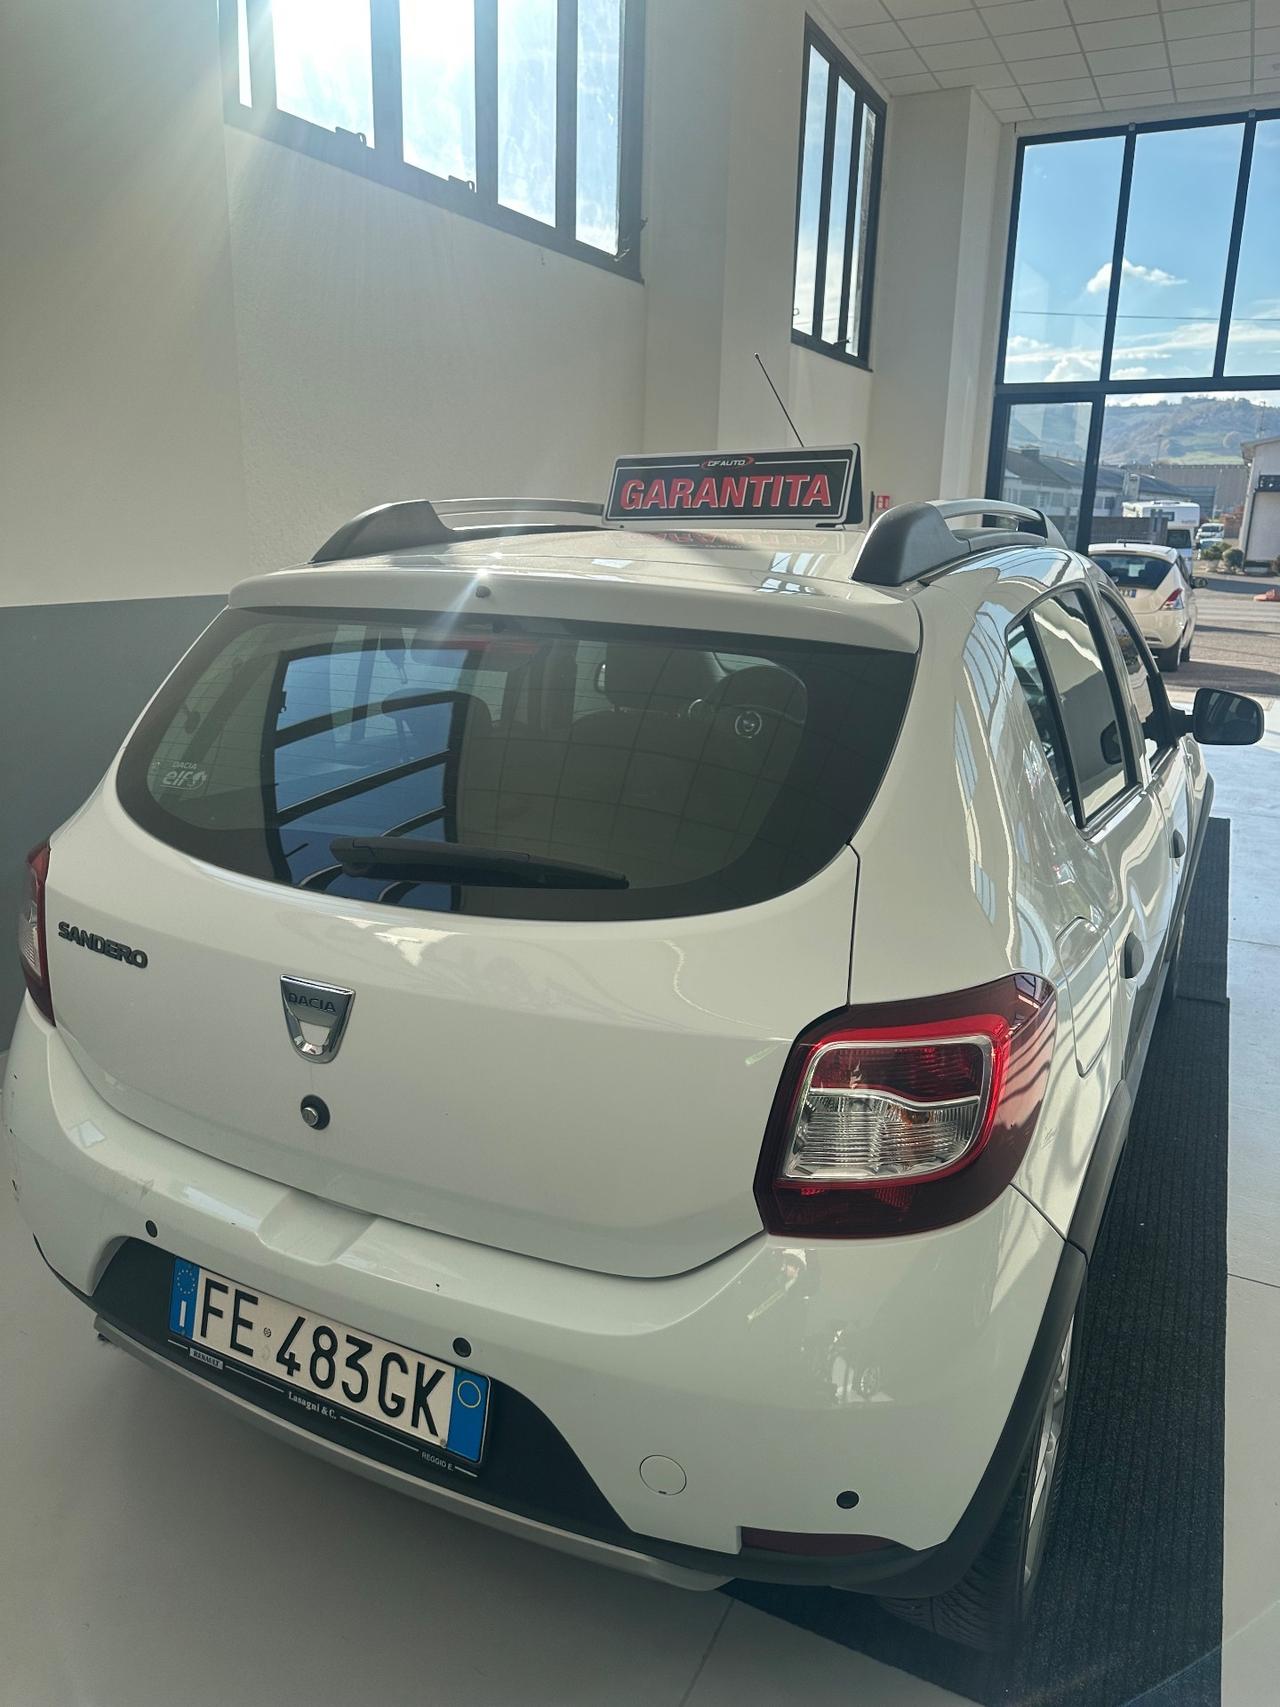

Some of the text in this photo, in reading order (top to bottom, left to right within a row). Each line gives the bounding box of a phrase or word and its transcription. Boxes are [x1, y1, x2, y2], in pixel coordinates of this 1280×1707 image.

[620, 474, 832, 510] GARANTITA
[162, 770, 194, 786] elf
[58, 921, 148, 969] SANDERO
[288, 992, 337, 1013] DACIA
[199, 1277, 446, 1438] FE 483GK
[421, 1451, 447, 1468] REGGIO
